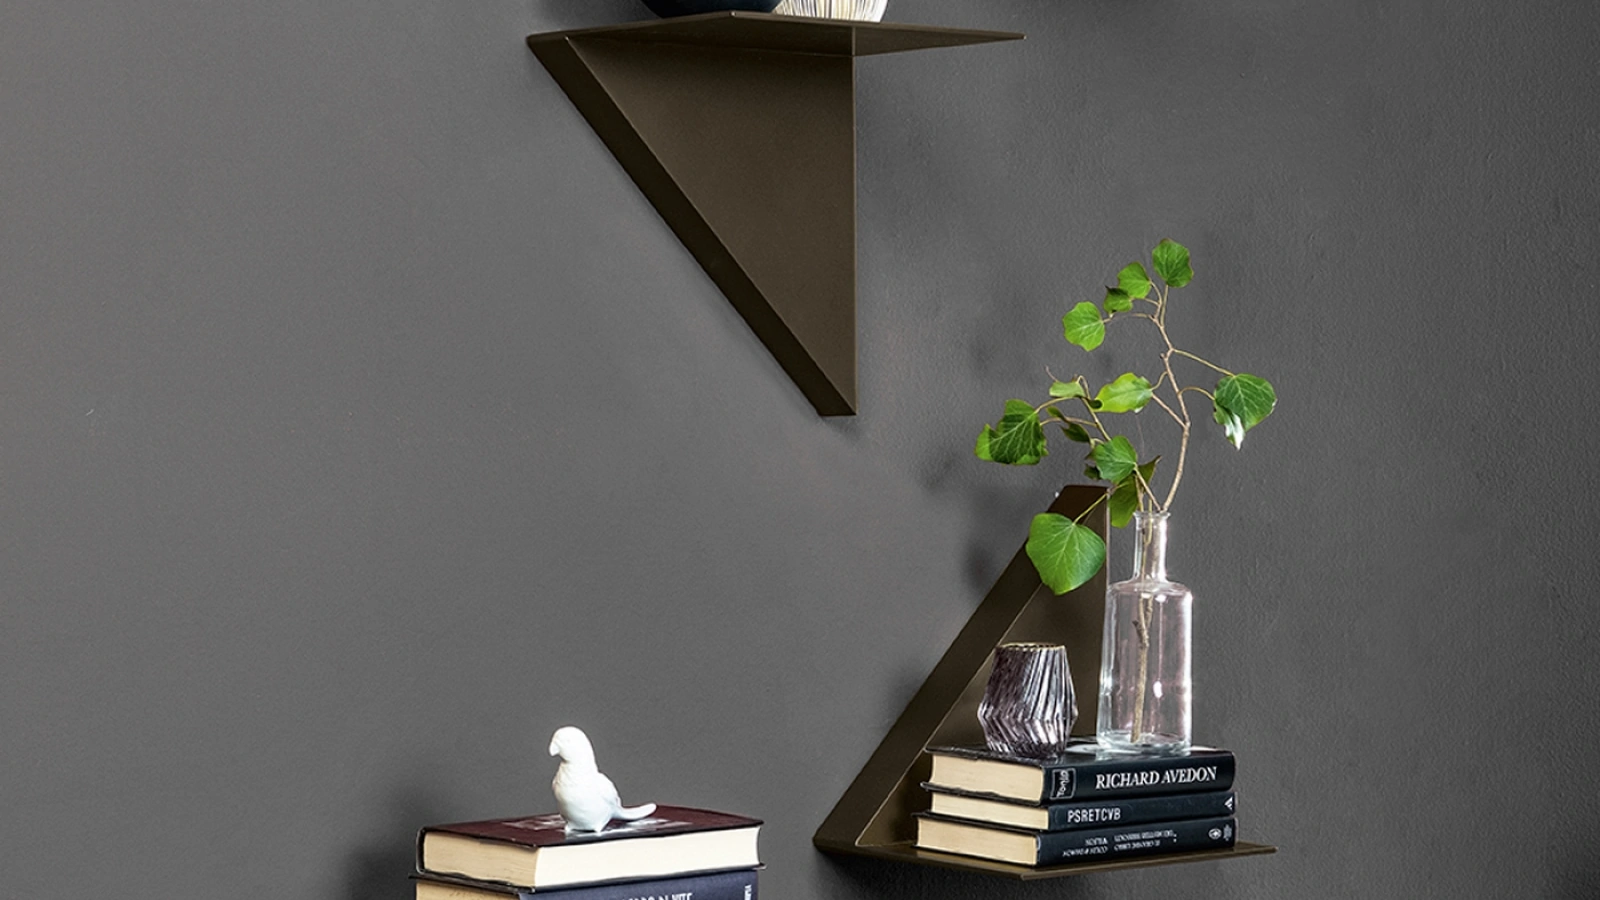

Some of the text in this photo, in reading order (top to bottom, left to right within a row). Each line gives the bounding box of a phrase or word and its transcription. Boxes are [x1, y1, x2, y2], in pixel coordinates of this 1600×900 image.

[1095, 766, 1217, 789] RICHARD AVEDON
[1067, 807, 1121, 823] PSRETCVB
